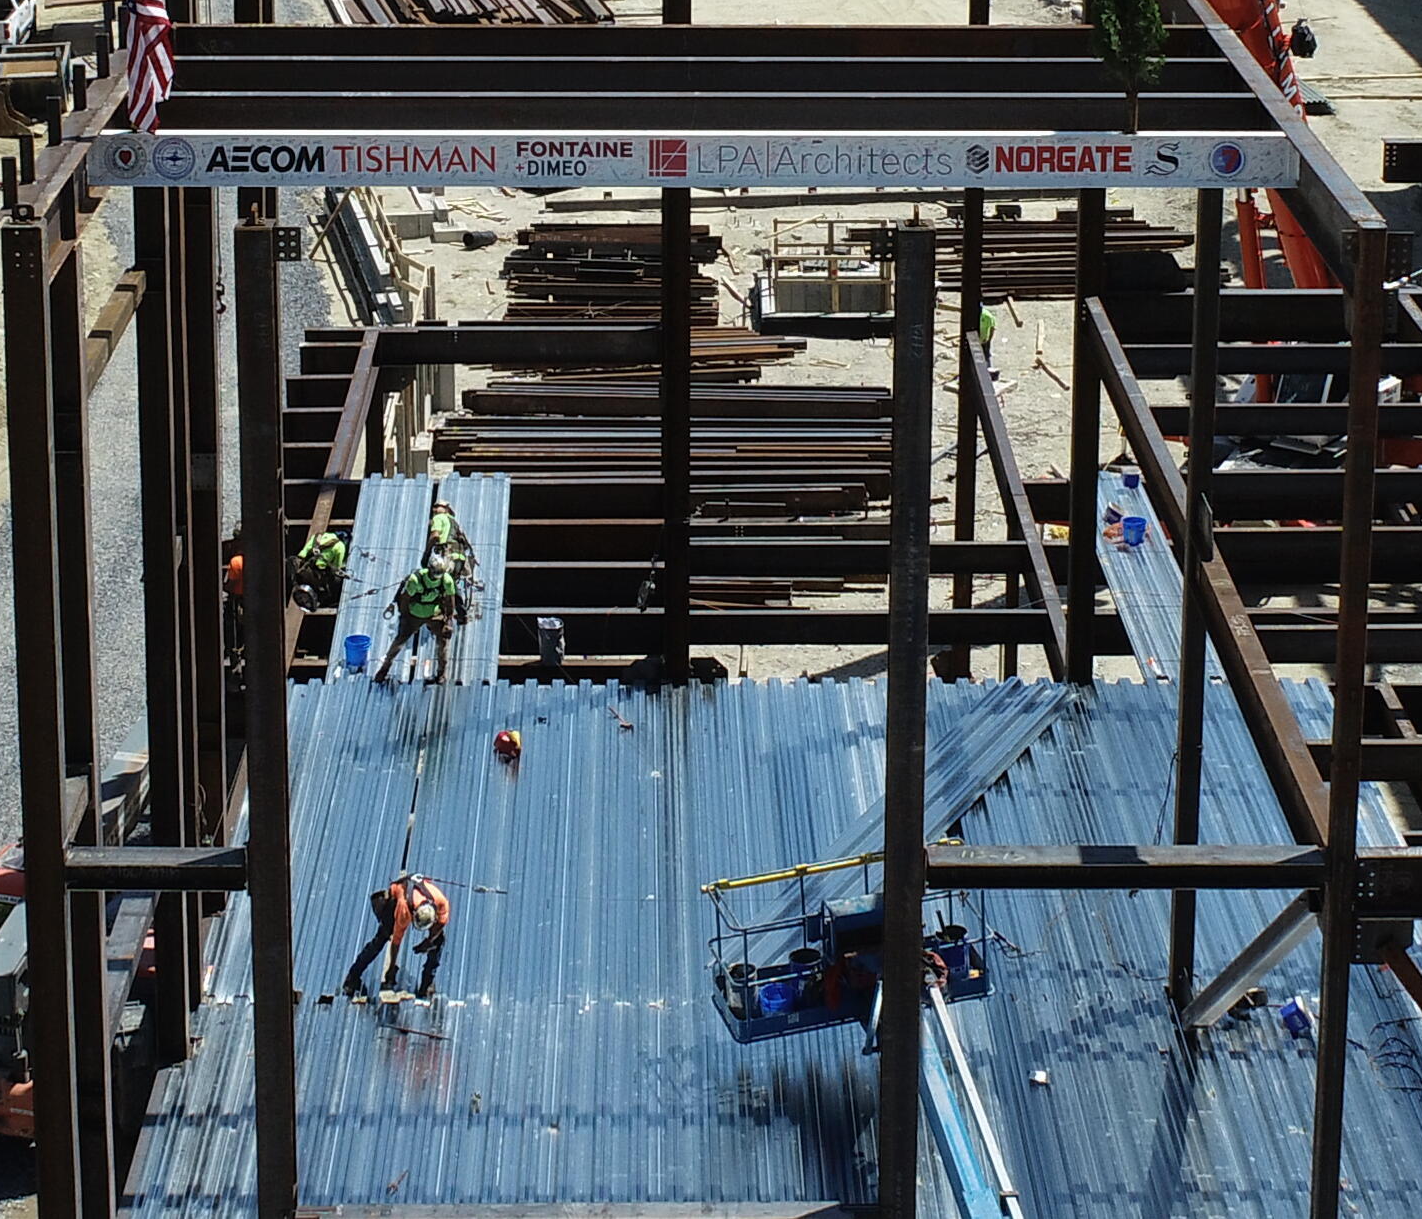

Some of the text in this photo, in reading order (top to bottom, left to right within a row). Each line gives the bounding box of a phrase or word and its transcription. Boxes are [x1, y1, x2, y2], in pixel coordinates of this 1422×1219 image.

[205, 145, 325, 172] AECOM
[333, 145, 496, 173] TISHMAN
[516, 141, 633, 158] FONTAINE
[994, 145, 1132, 173] NORGATE
